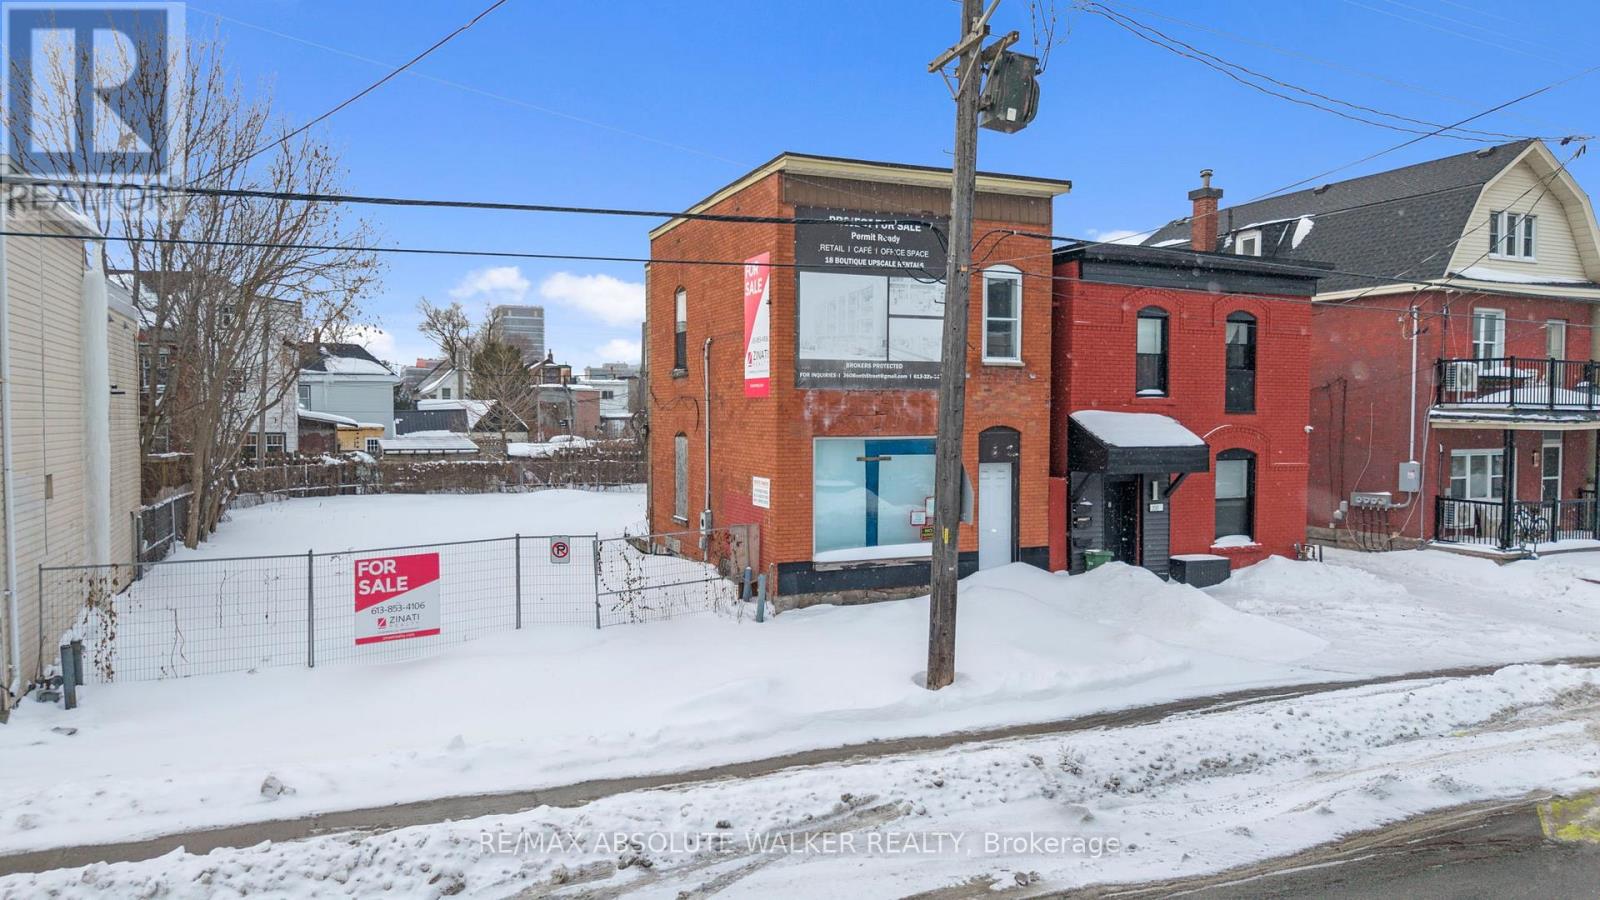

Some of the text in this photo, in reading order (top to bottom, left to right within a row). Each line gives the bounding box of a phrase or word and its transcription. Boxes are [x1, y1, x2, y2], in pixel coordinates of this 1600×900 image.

[897, 221, 922, 232] SALE
[851, 232, 901, 244] Permit Ready
[820, 244, 929, 258] RETAIL CAFÉ OFFICE SPACE
[825, 256, 833, 264] 18
[835, 257, 867, 266] BOUTIQUE
[868, 259, 896, 267] UPSCALE
[745, 277, 763, 296] SALE
[358, 559, 397, 577] FOR
[358, 576, 409, 596] SALE
[371, 602, 426, 615] 613-853-4106
[389, 614, 420, 624] ZINATI
